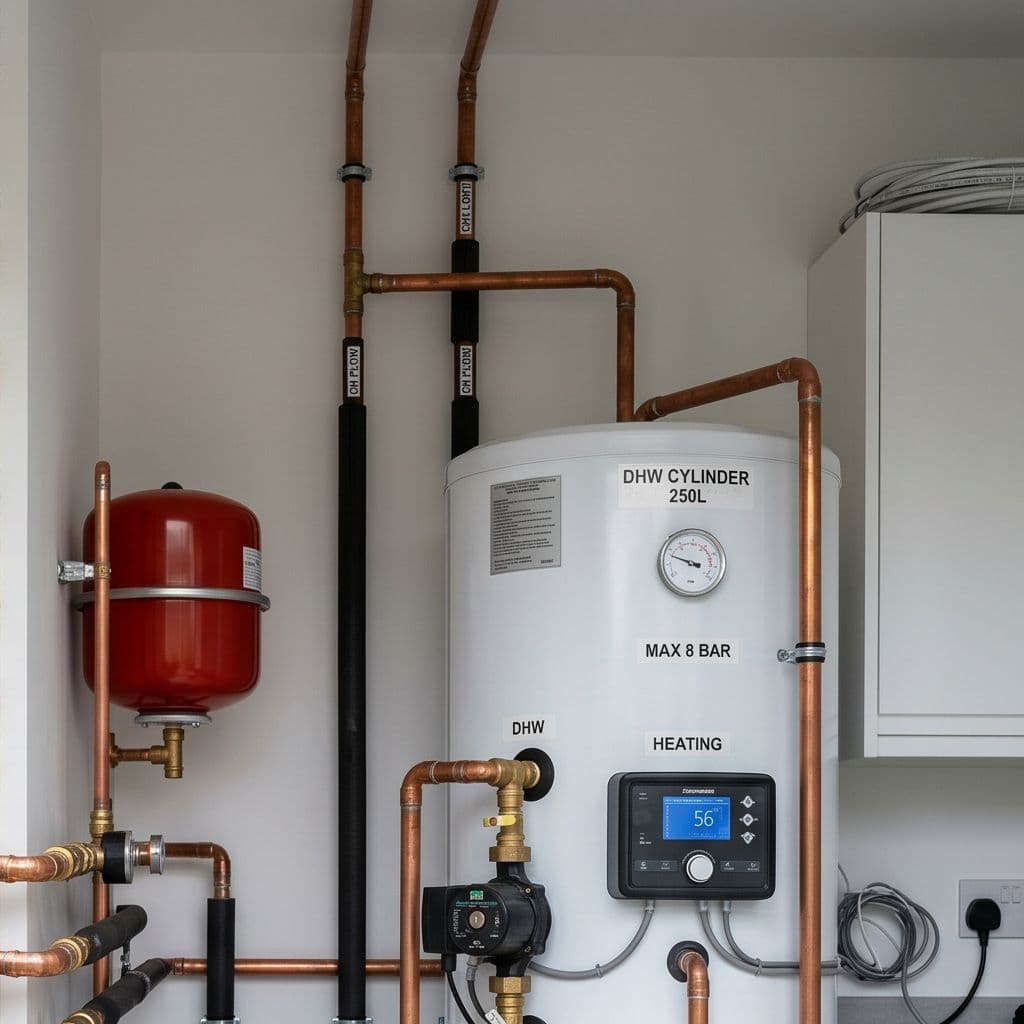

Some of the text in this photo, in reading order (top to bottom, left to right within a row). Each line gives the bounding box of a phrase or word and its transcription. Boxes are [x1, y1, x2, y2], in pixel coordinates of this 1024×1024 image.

[623, 468, 750, 486] DHW CYLINDER
[669, 488, 707, 504] 250L
[646, 643, 731, 658] MAX 8 BAR
[512, 720, 545, 736] DHW
[653, 737, 722, 751] HEATING
[694, 810, 714, 827] 56
